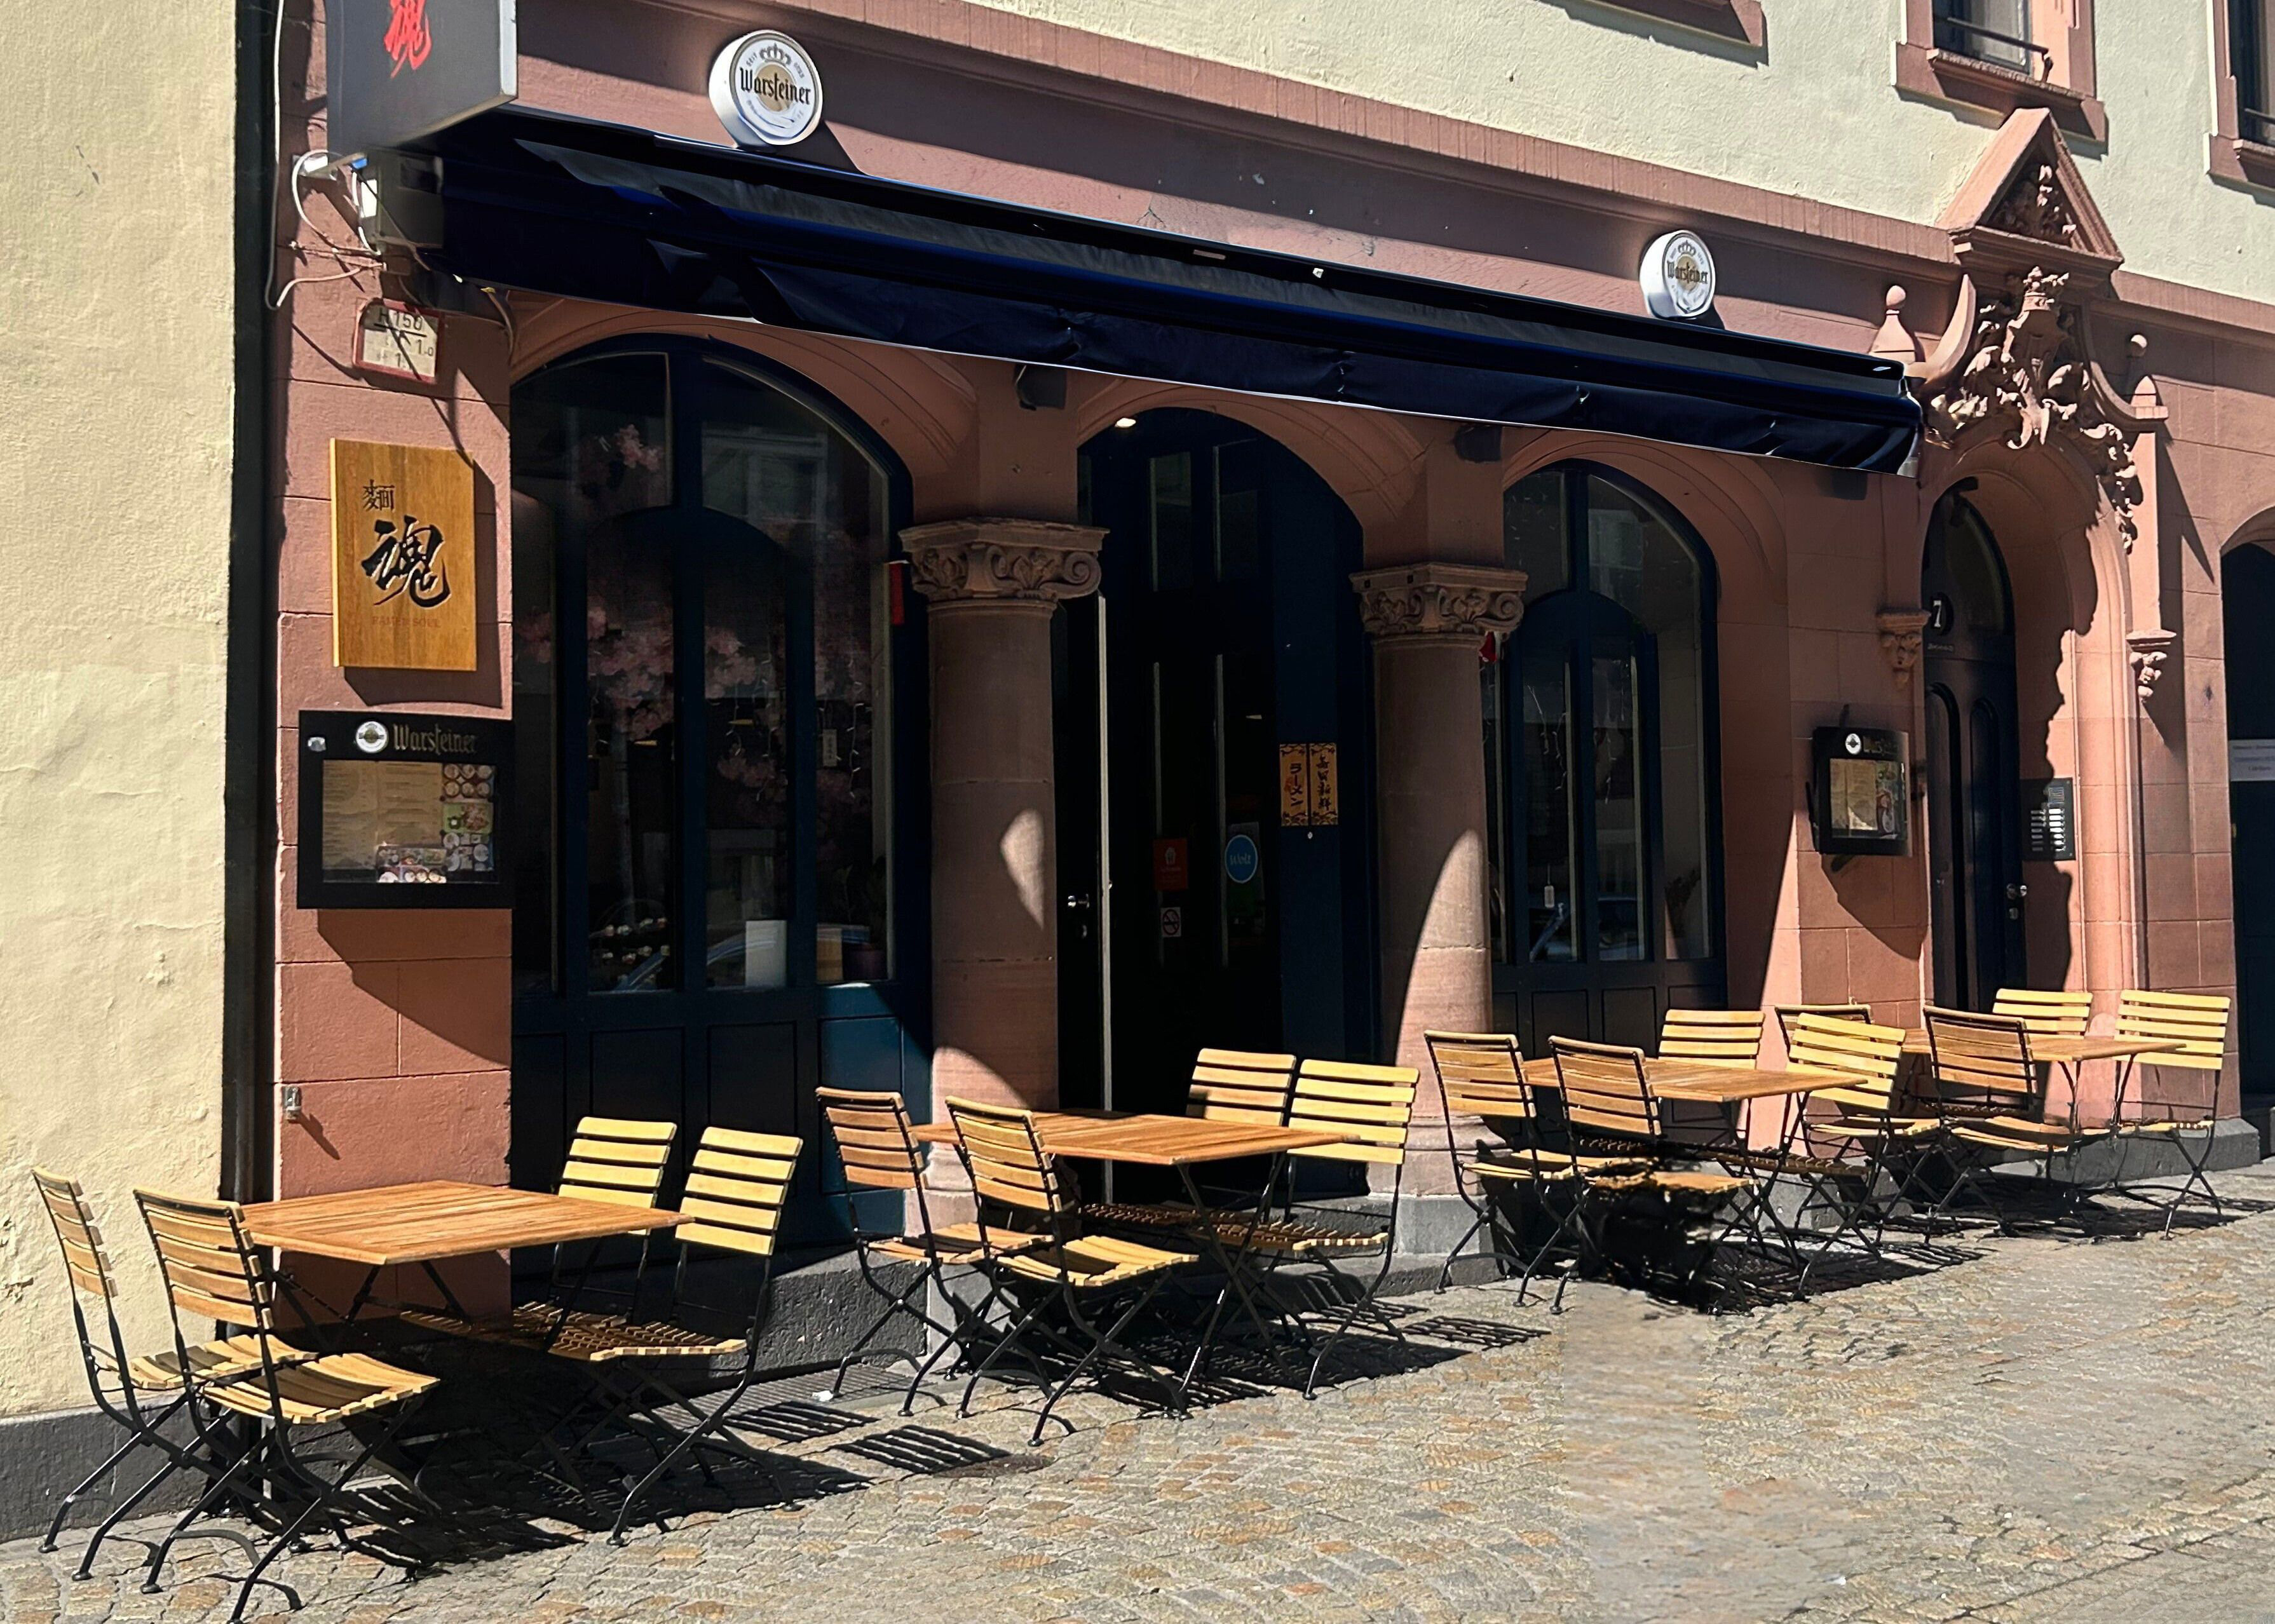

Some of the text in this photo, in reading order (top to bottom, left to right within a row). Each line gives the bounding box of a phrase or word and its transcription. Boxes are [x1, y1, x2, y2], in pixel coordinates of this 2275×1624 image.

[740, 66, 812, 105] Warsteiner
[361, 515, 451, 607] 魂
[1933, 600, 1942, 628] 7
[393, 723, 477, 755] Warsteiner
[1290, 763, 1304, 807] ラーメン
